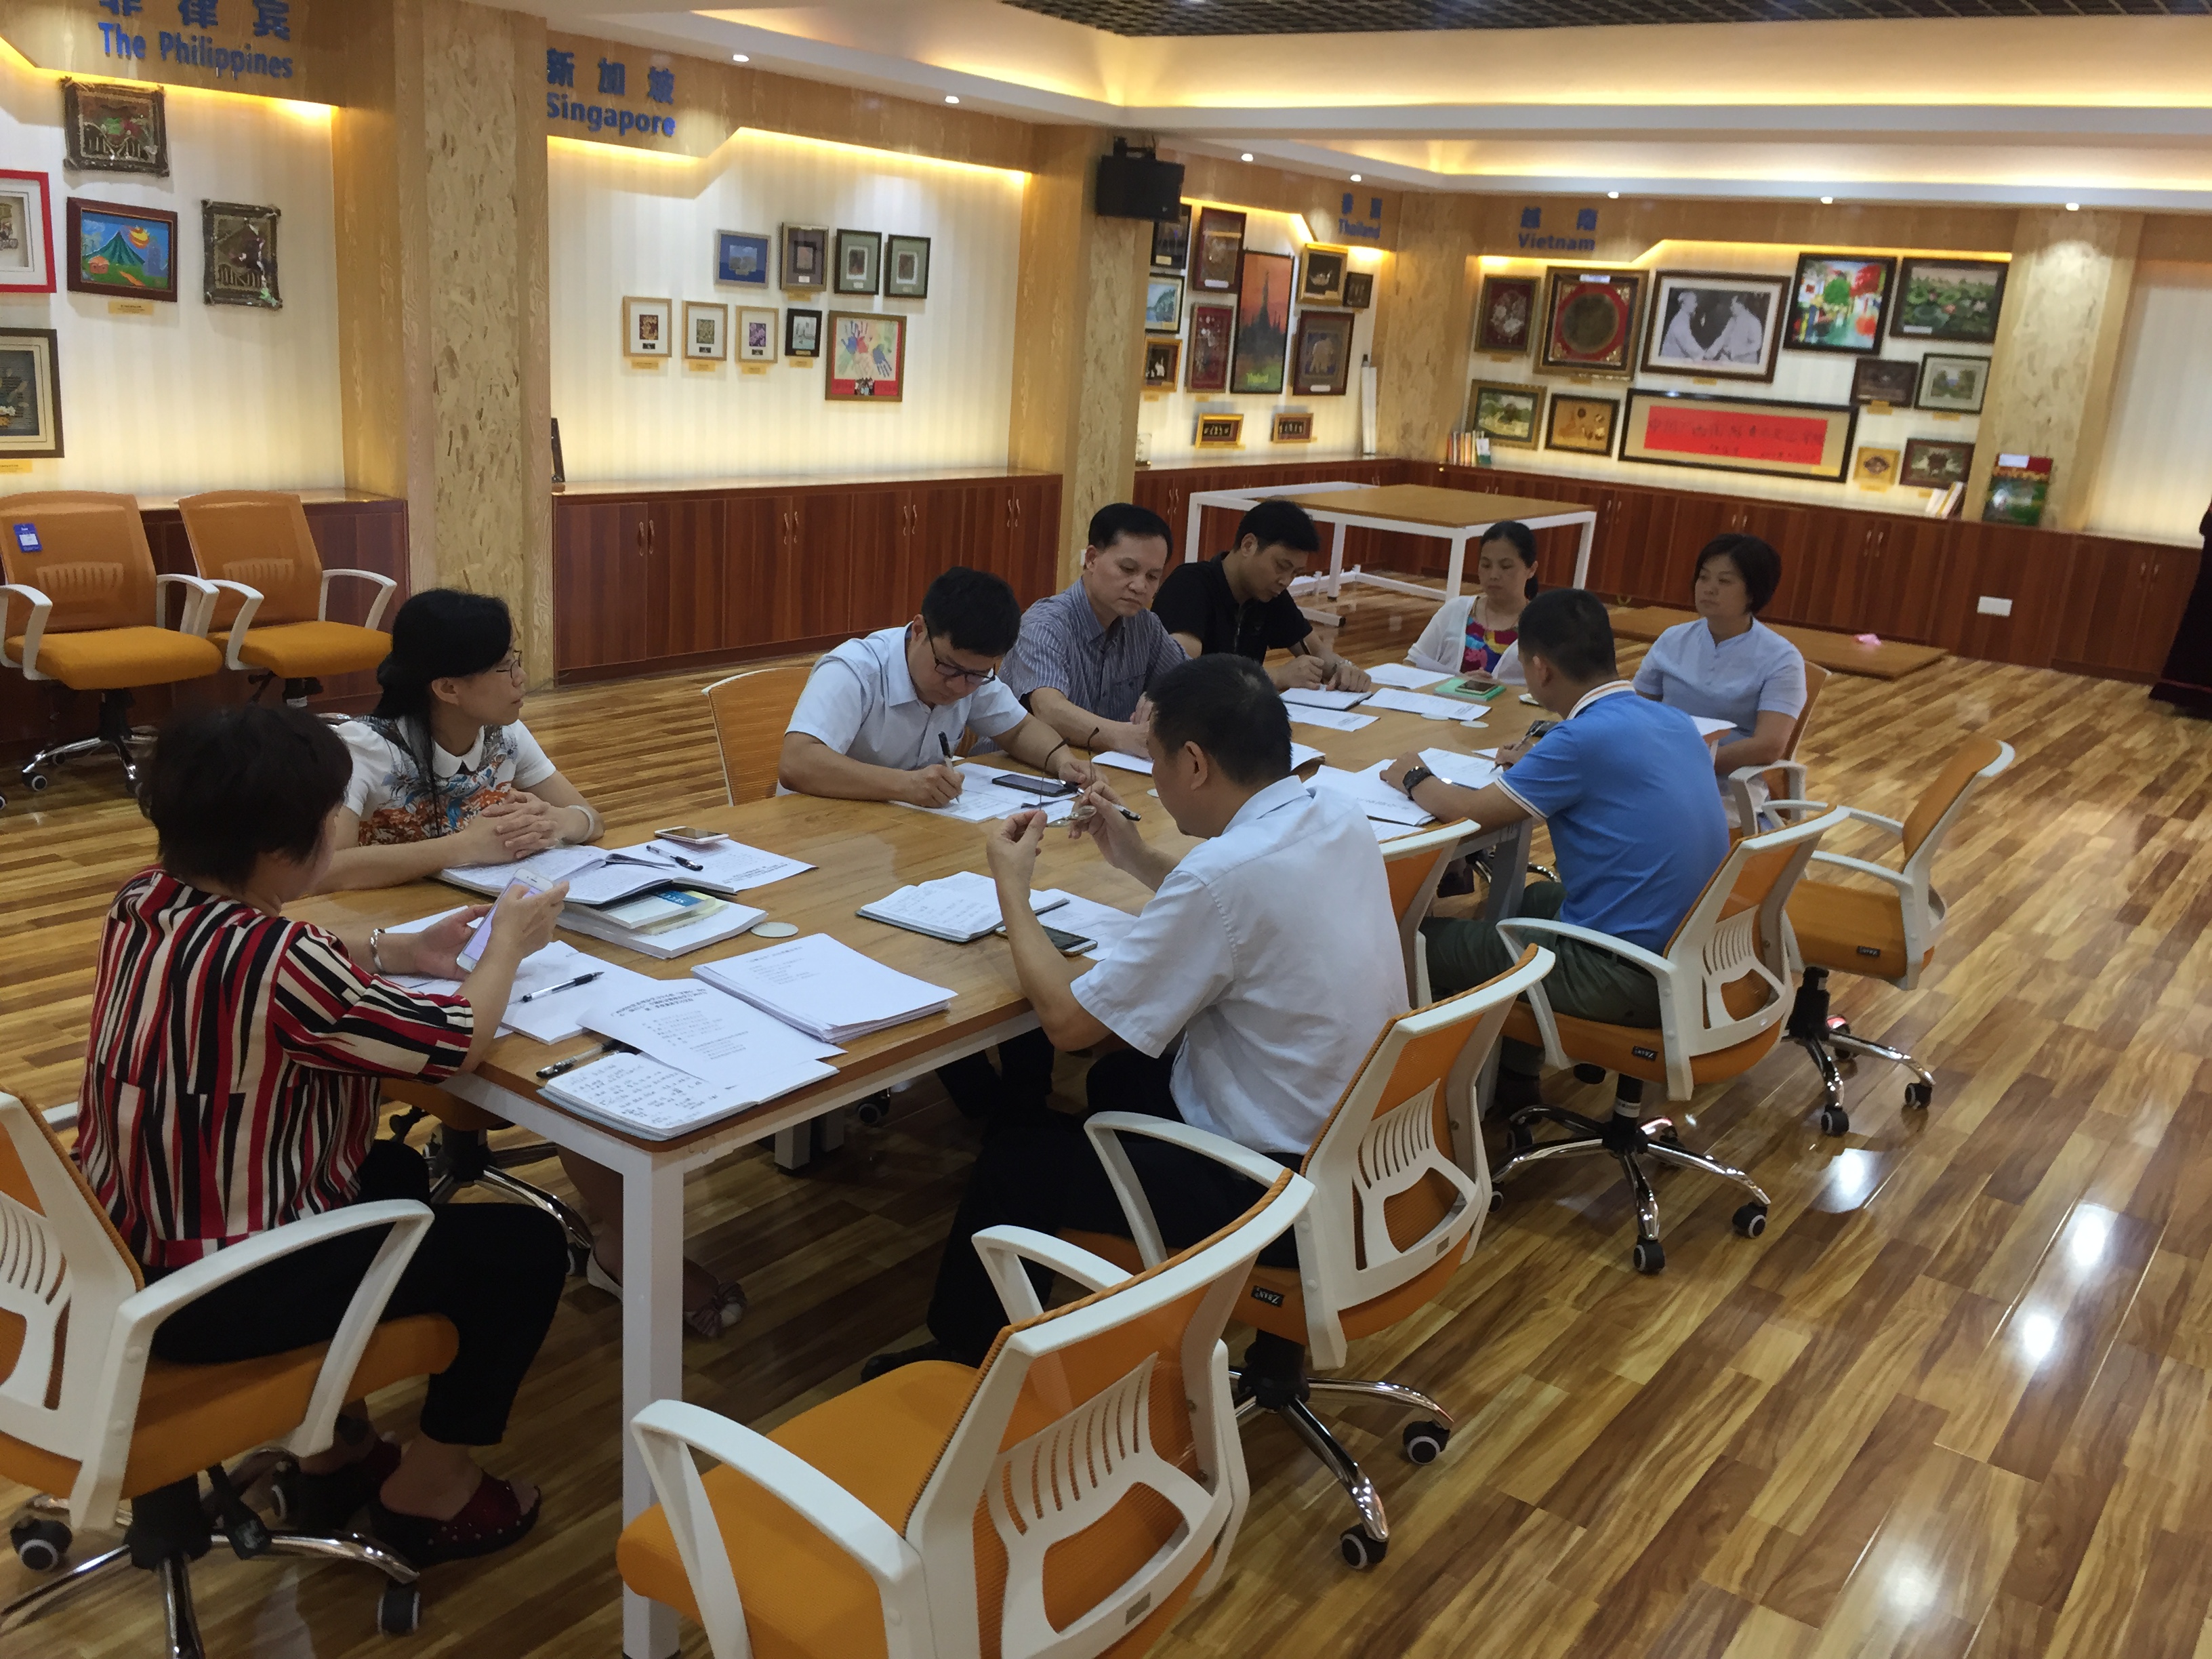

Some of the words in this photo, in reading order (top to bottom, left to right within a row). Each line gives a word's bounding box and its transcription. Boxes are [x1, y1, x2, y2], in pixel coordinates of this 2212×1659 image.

[98, 22, 146, 59] The
[159, 30, 293, 80] Philippines
[547, 48, 675, 104] 新加坡
[547, 92, 676, 136] Singapore
[1518, 232, 1596, 251] Vietnam
